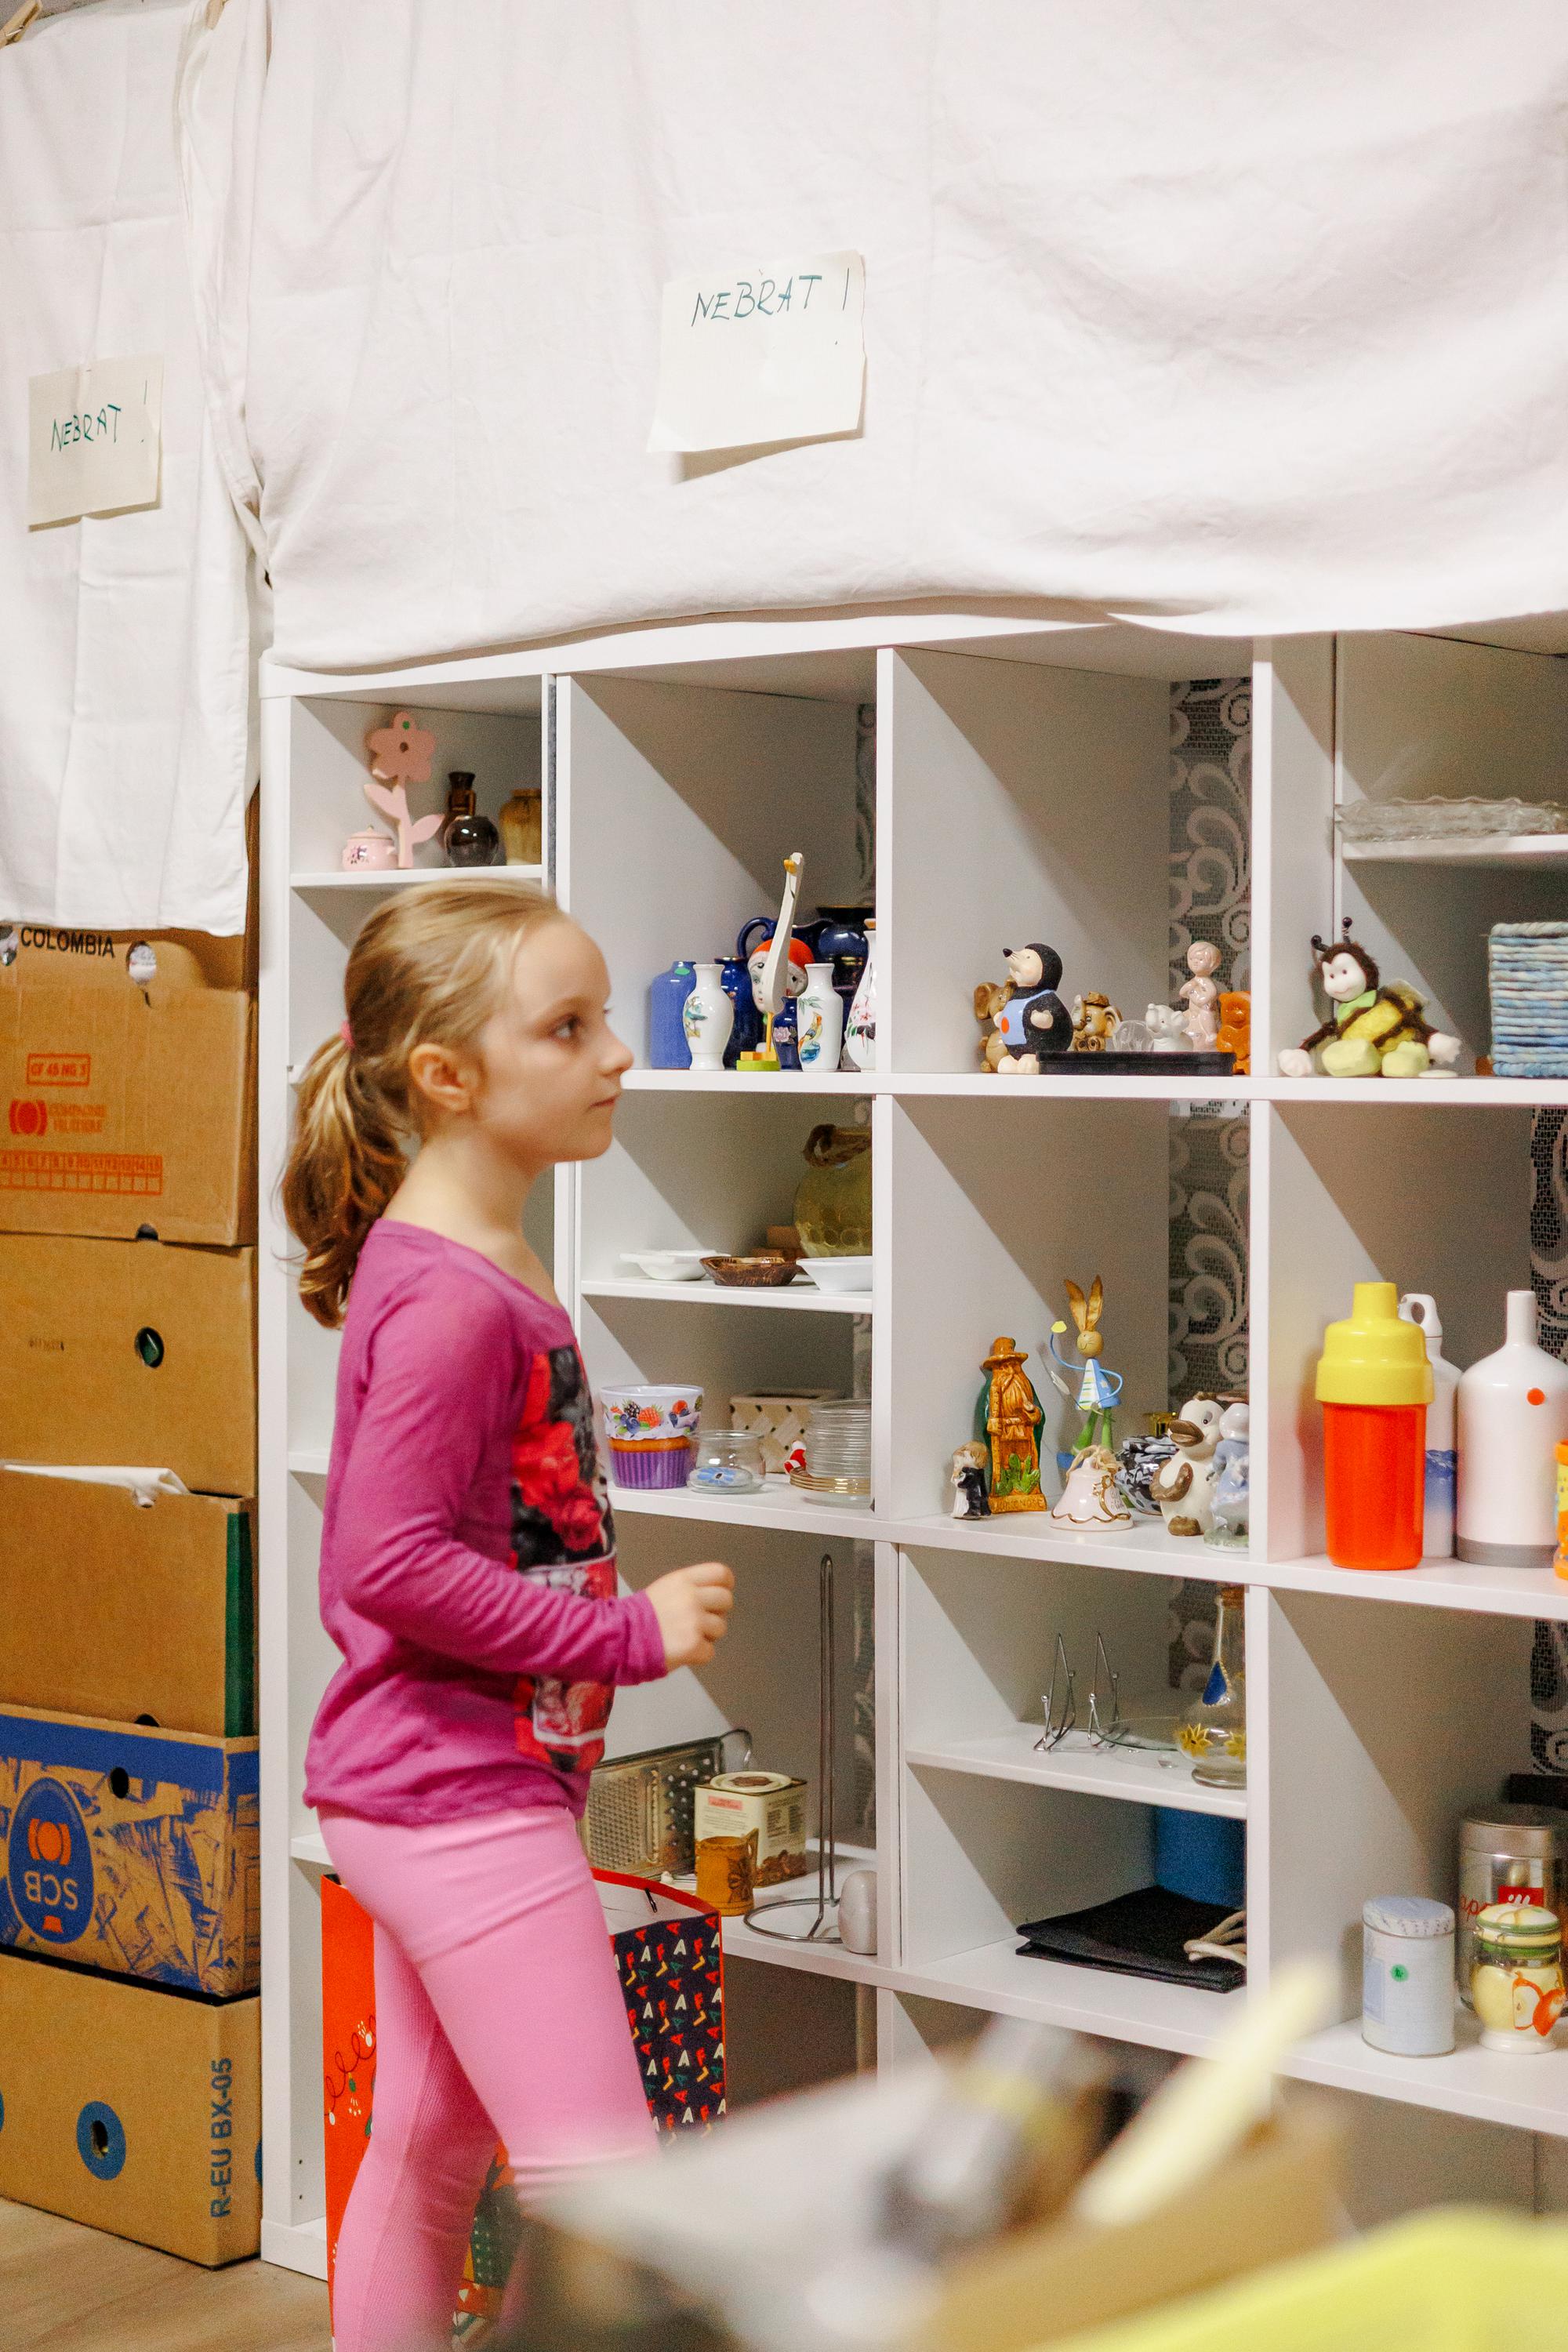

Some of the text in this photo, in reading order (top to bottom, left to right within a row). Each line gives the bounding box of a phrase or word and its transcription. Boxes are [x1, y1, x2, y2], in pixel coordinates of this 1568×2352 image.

[691, 274, 822, 327] NEBRAT
[51, 403, 122, 452] NEBRAT
[21, 927, 116, 959] COLOMBIA
[24, 1871, 78, 1911] SCB
[210, 2057, 233, 2218] R-EU BX-05
